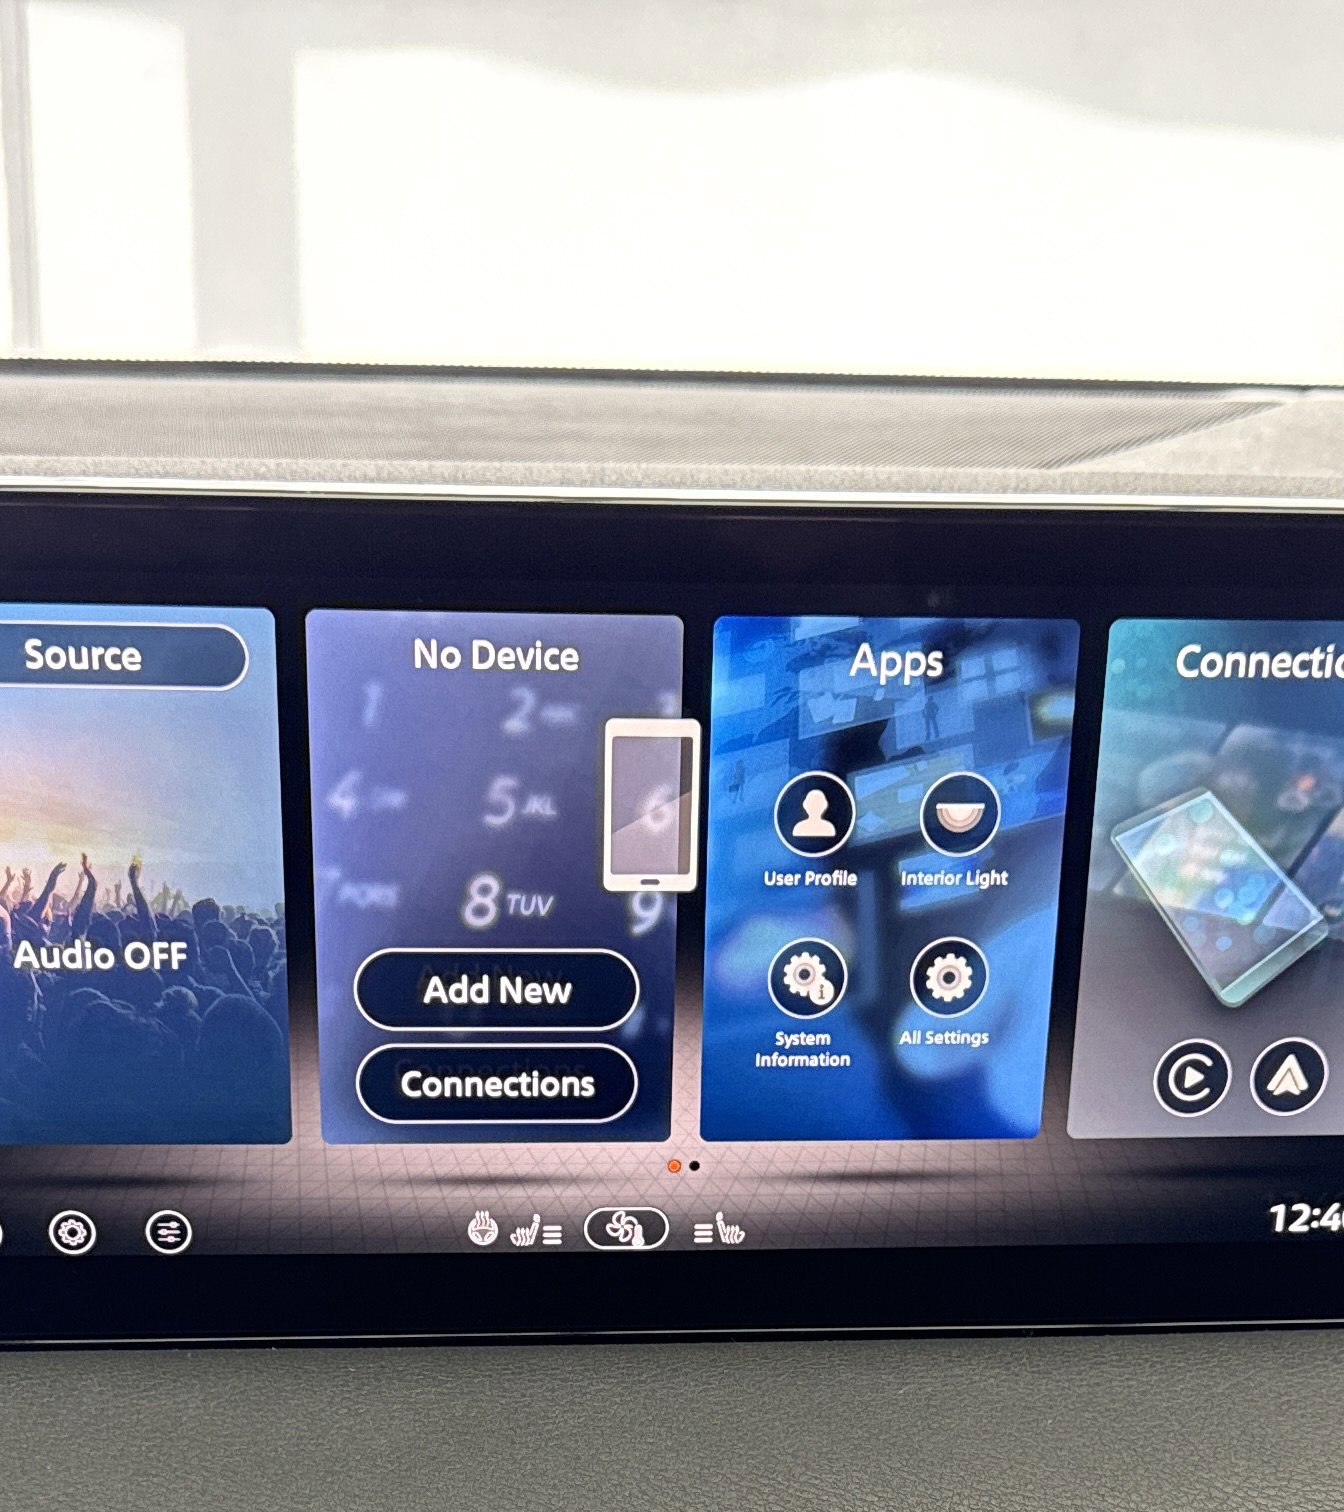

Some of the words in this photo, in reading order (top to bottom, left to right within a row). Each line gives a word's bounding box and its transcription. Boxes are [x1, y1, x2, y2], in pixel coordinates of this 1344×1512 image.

[25, 638, 142, 673] Source
[414, 638, 462, 670] No
[472, 638, 580, 673] Device
[850, 642, 944, 684] Apps
[483, 775, 518, 828] 5
[764, 870, 804, 886] User
[808, 869, 858, 887] Profile
[901, 869, 962, 887] Interior
[964, 869, 1009, 890] Light
[463, 873, 501, 928] 8
[506, 892, 555, 918] TUV
[13, 941, 114, 972] Audio
[124, 941, 189, 971] OFF
[422, 973, 491, 1005] Add
[500, 974, 573, 1005] New
[774, 1031, 832, 1051] System
[899, 1029, 922, 1046] All
[925, 1029, 990, 1049] Settings
[755, 1051, 851, 1069] Information
[401, 1070, 596, 1100] Connections
